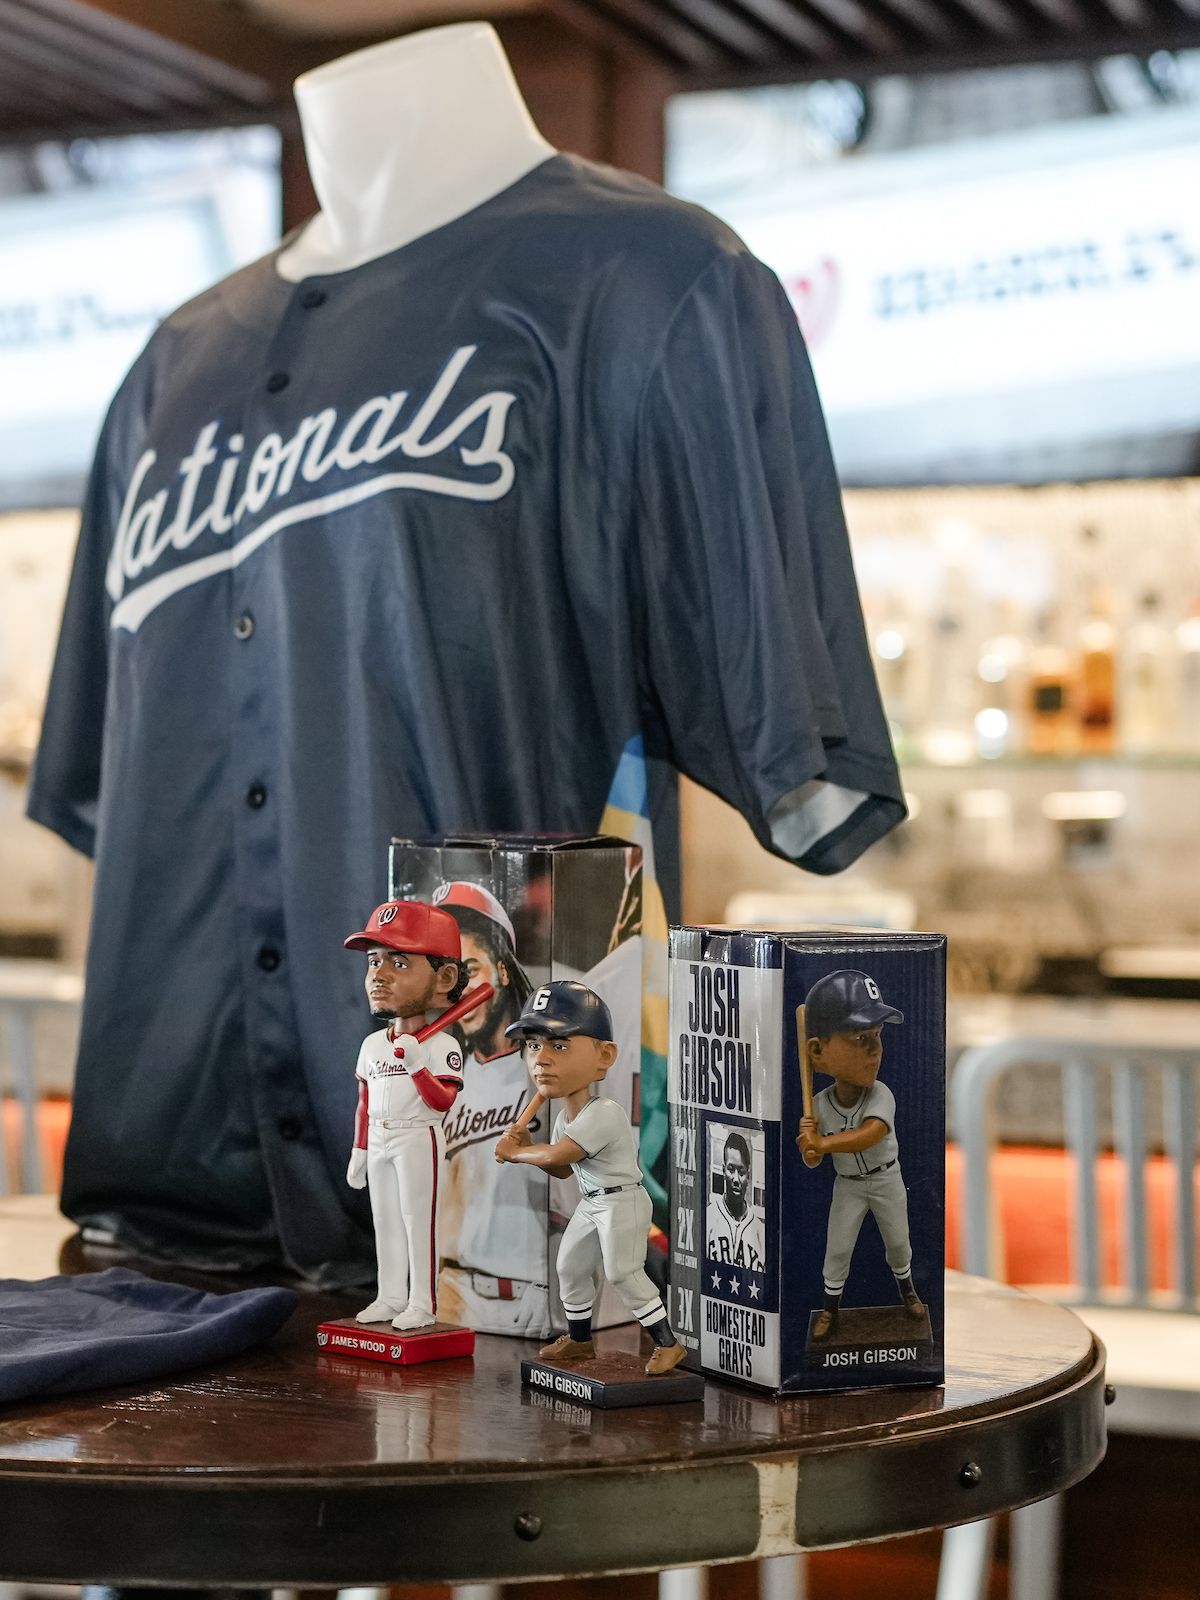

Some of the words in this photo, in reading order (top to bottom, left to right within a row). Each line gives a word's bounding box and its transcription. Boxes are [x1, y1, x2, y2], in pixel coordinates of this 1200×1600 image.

[532, 989, 551, 1011] G
[688, 964, 740, 1039] JOSH
[864, 978, 880, 1000] G
[679, 1033, 752, 1114] GIBSON
[677, 1206, 695, 1252] 2X
[677, 1286, 694, 1333] 3X
[706, 1299, 766, 1348] HOMESTEAD
[331, 1335, 359, 1349] JAMES
[359, 1339, 386, 1353] WOOD
[718, 1337, 753, 1379] GRAYS
[822, 1351, 859, 1367] JOSH
[863, 1347, 917, 1364] GIBSON
[529, 1368, 554, 1389] JOSH
[555, 1376, 592, 1400] GIBSON
